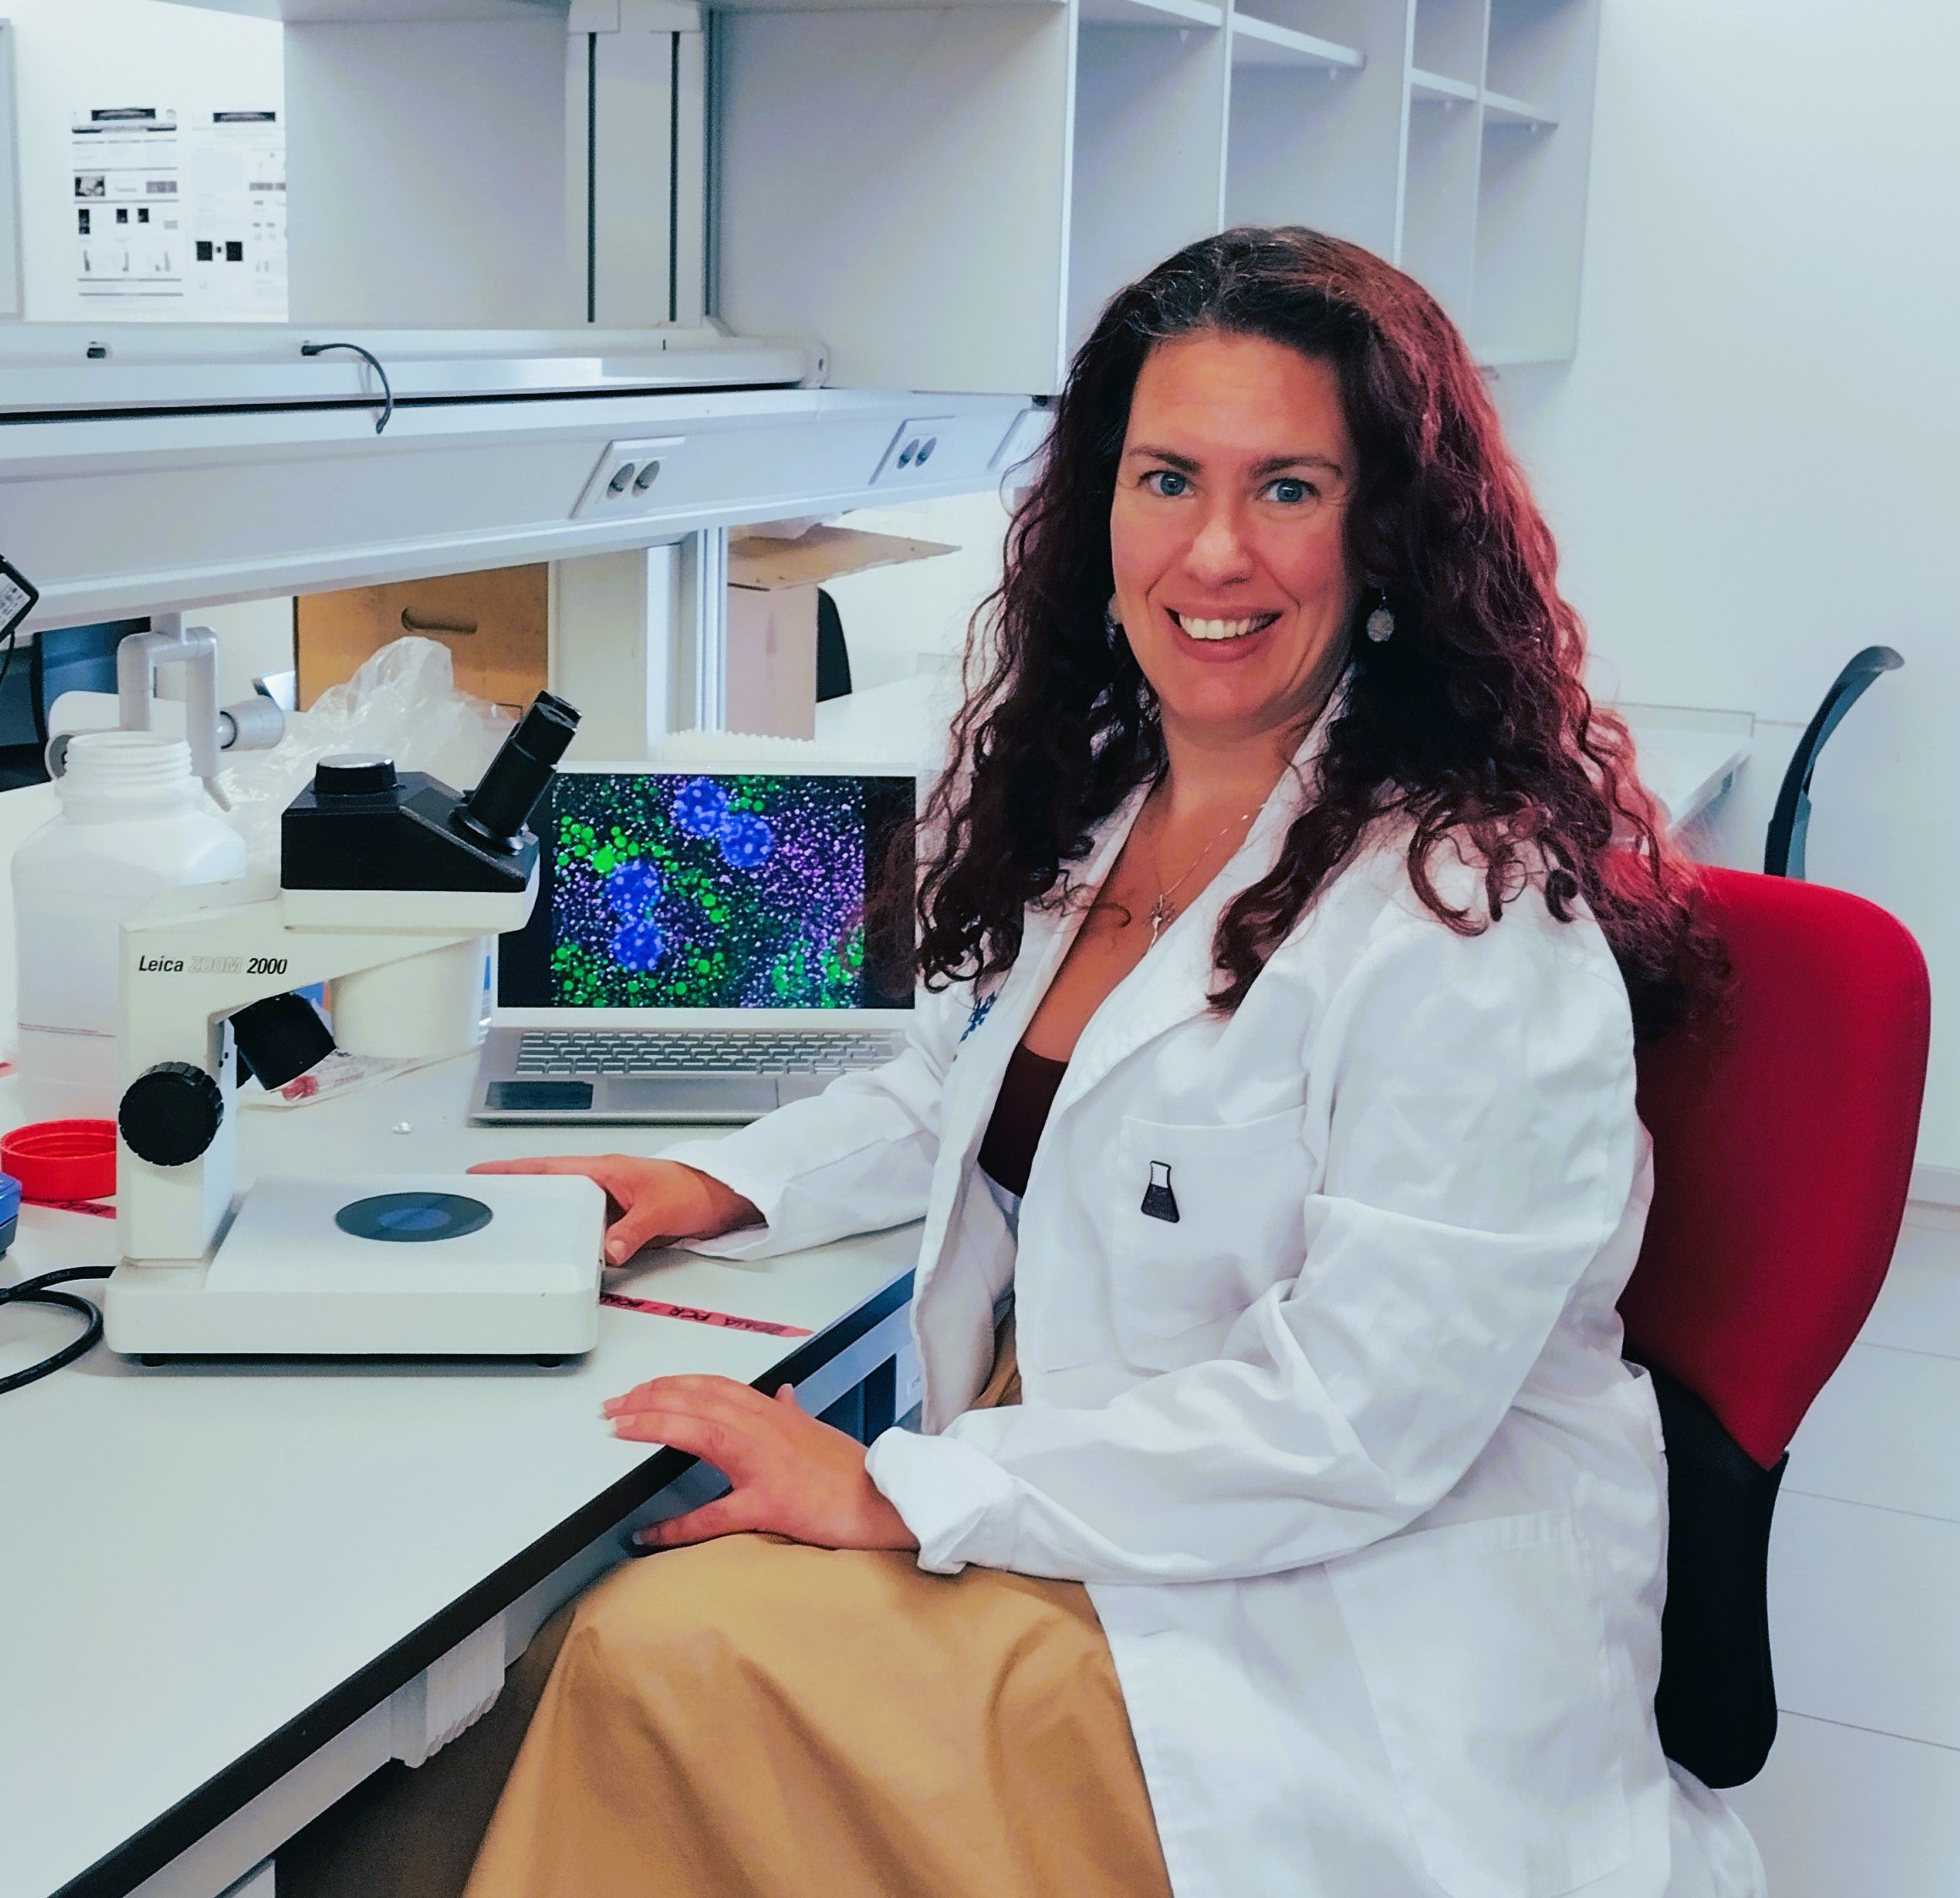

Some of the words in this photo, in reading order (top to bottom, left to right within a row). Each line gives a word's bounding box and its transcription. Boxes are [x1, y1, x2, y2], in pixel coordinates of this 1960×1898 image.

[139, 955, 183, 972] Leica
[188, 955, 243, 973] ZOOM
[247, 958, 288, 975] 2000
